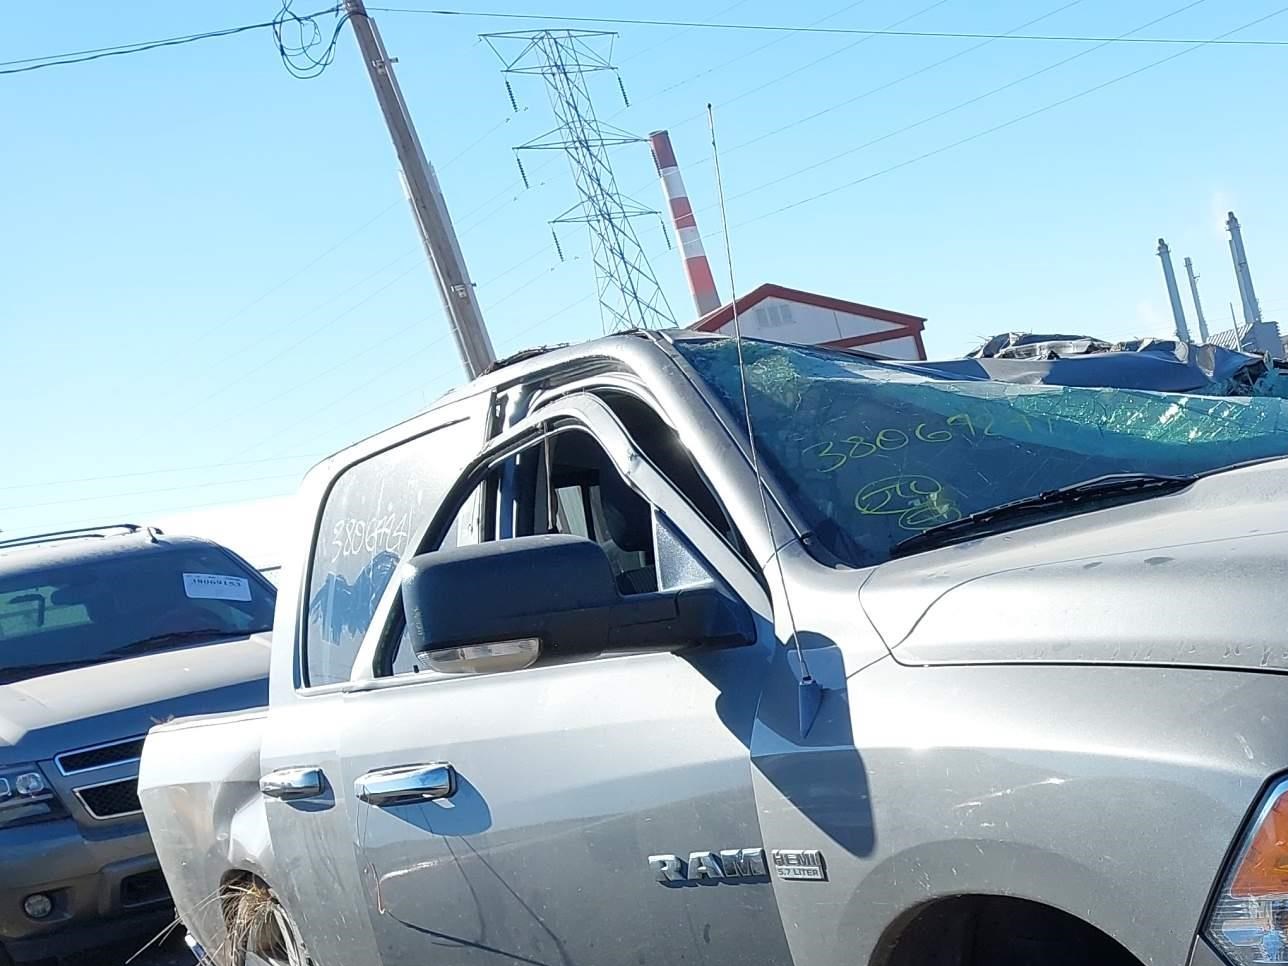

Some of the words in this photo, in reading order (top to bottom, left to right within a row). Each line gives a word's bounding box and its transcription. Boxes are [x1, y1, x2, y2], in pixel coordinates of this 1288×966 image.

[648, 848, 768, 882] RAM
[772, 850, 821, 866] HEMI
[777, 868, 790, 876] 5.7
[793, 868, 819, 876] LITER
